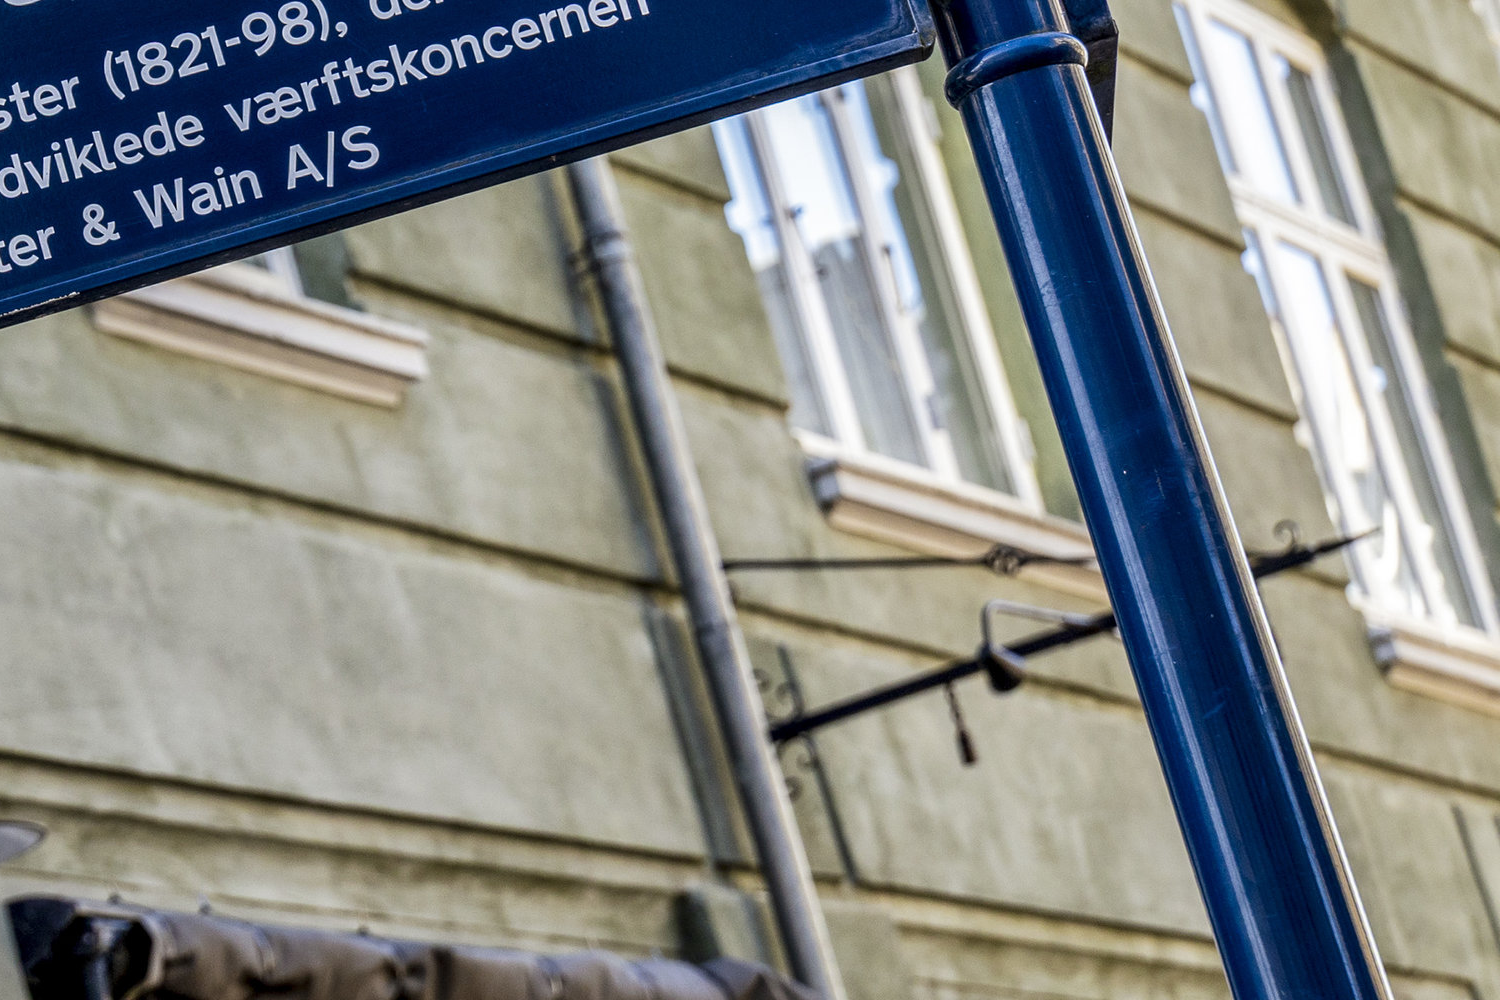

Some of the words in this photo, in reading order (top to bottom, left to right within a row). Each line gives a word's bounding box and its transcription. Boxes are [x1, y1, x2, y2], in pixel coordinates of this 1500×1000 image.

[83, 204, 120, 245] &
[133, 167, 262, 228] Wain
[288, 126, 379, 189] A/S
